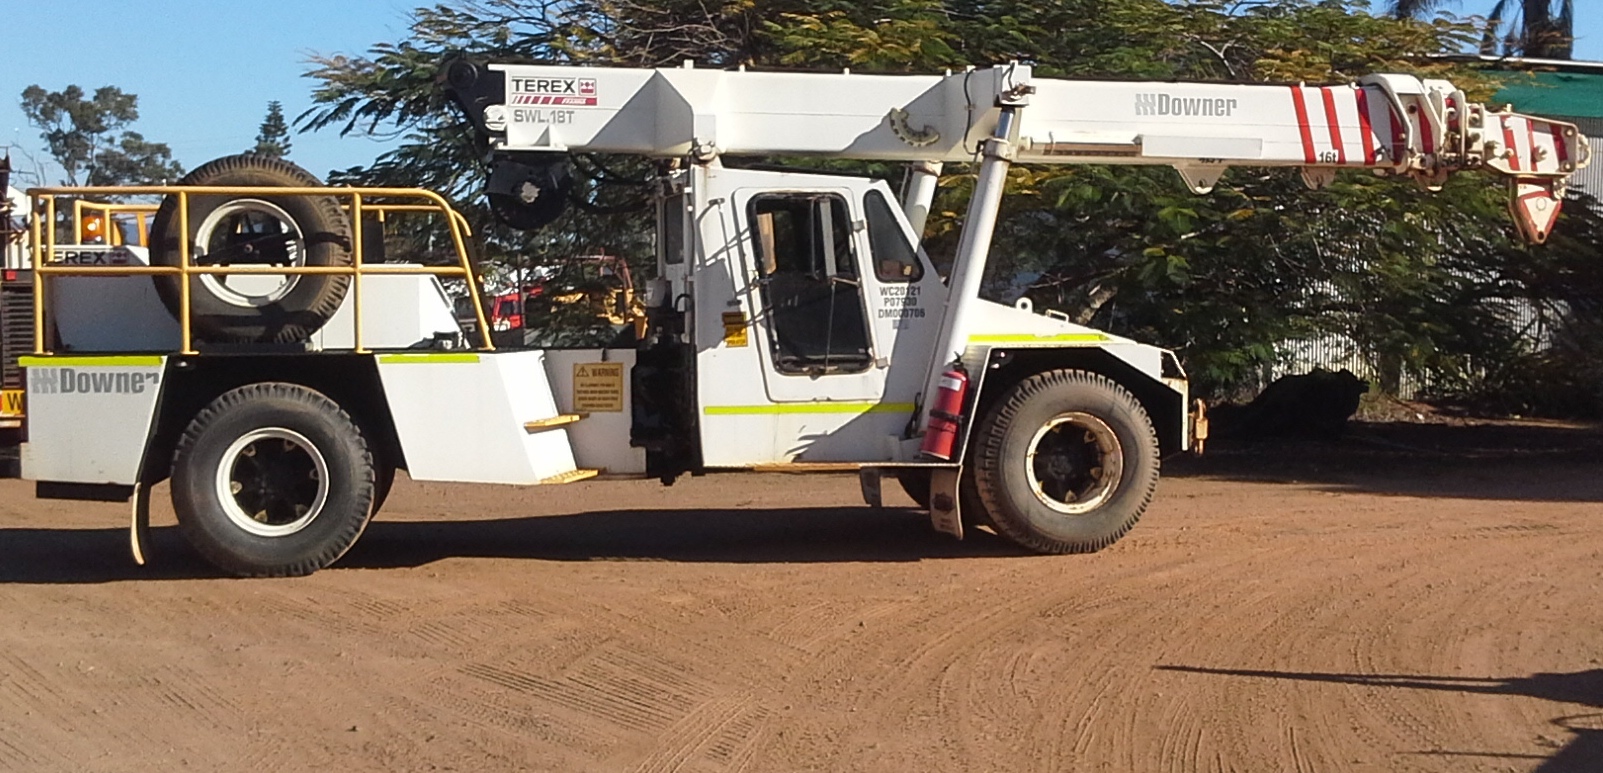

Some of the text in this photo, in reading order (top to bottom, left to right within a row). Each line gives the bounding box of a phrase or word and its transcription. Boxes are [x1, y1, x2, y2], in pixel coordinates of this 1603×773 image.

[511, 79, 576, 93] TEREX
[1158, 93, 1237, 117] Downer
[1319, 151, 1337, 164] 16t
[53, 251, 106, 265] EREX
[591, 368, 620, 377] WARNING
